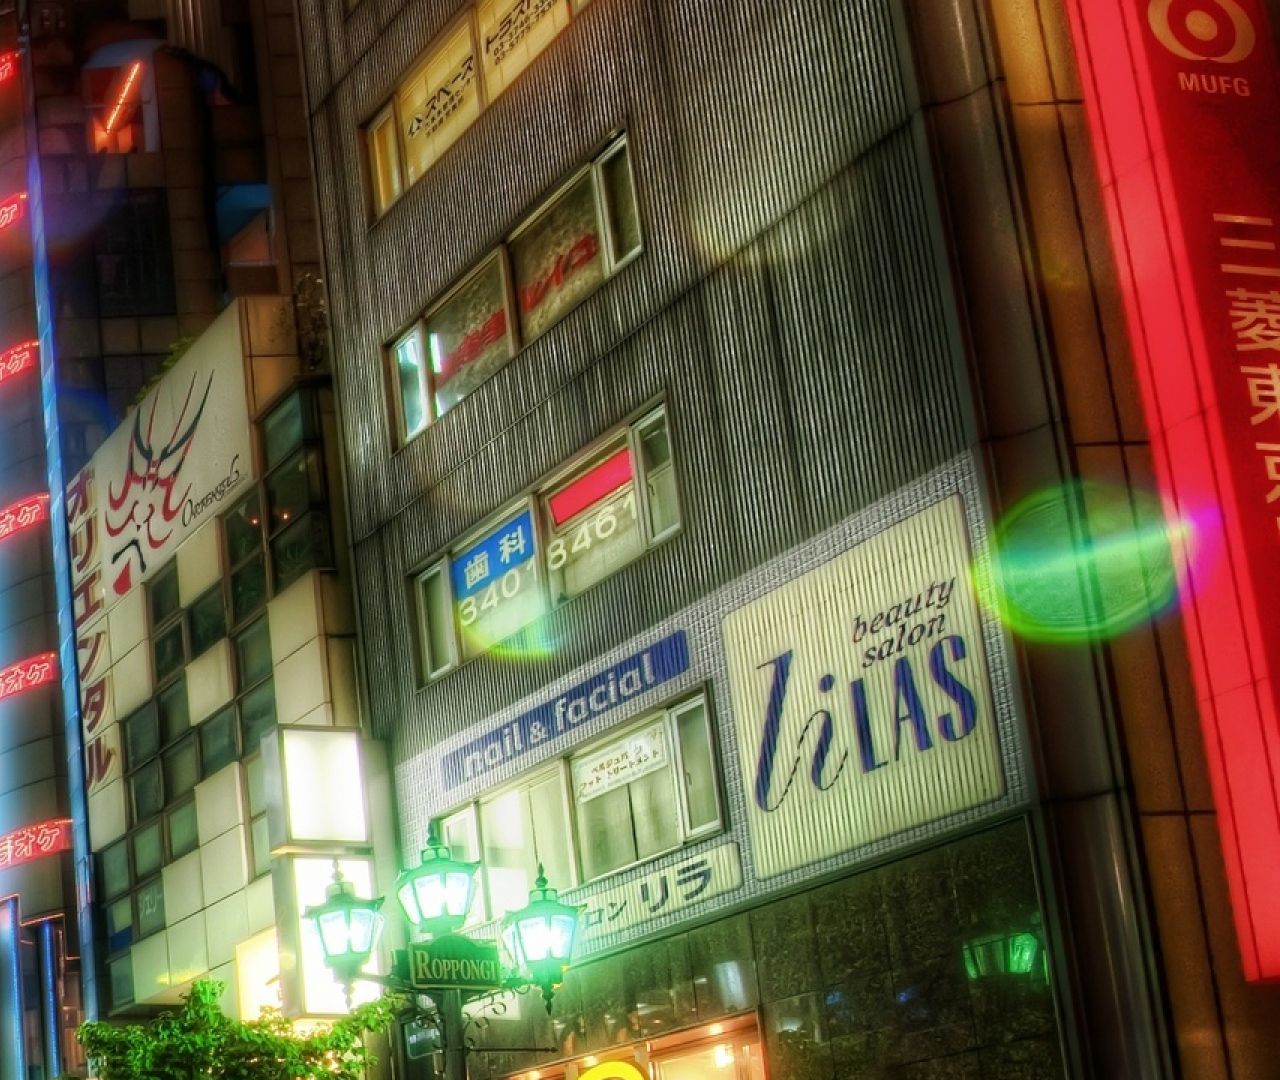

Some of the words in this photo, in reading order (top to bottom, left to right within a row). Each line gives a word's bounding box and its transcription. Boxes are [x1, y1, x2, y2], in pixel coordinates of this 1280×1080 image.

[1179, 72, 1251, 97] MUFG
[460, 555, 538, 626] 3401
[548, 490, 637, 571] 8461
[464, 525, 526, 589] 歯科
[67, 470, 114, 790] オリエンタル
[853, 576, 956, 644] beauty
[862, 612, 948, 668] salon
[464, 718, 522, 780] nail
[528, 718, 549, 744] &
[553, 652, 658, 731] facial
[640, 858, 712, 913] リラ
[414, 948, 498, 982] ROPPONGI
